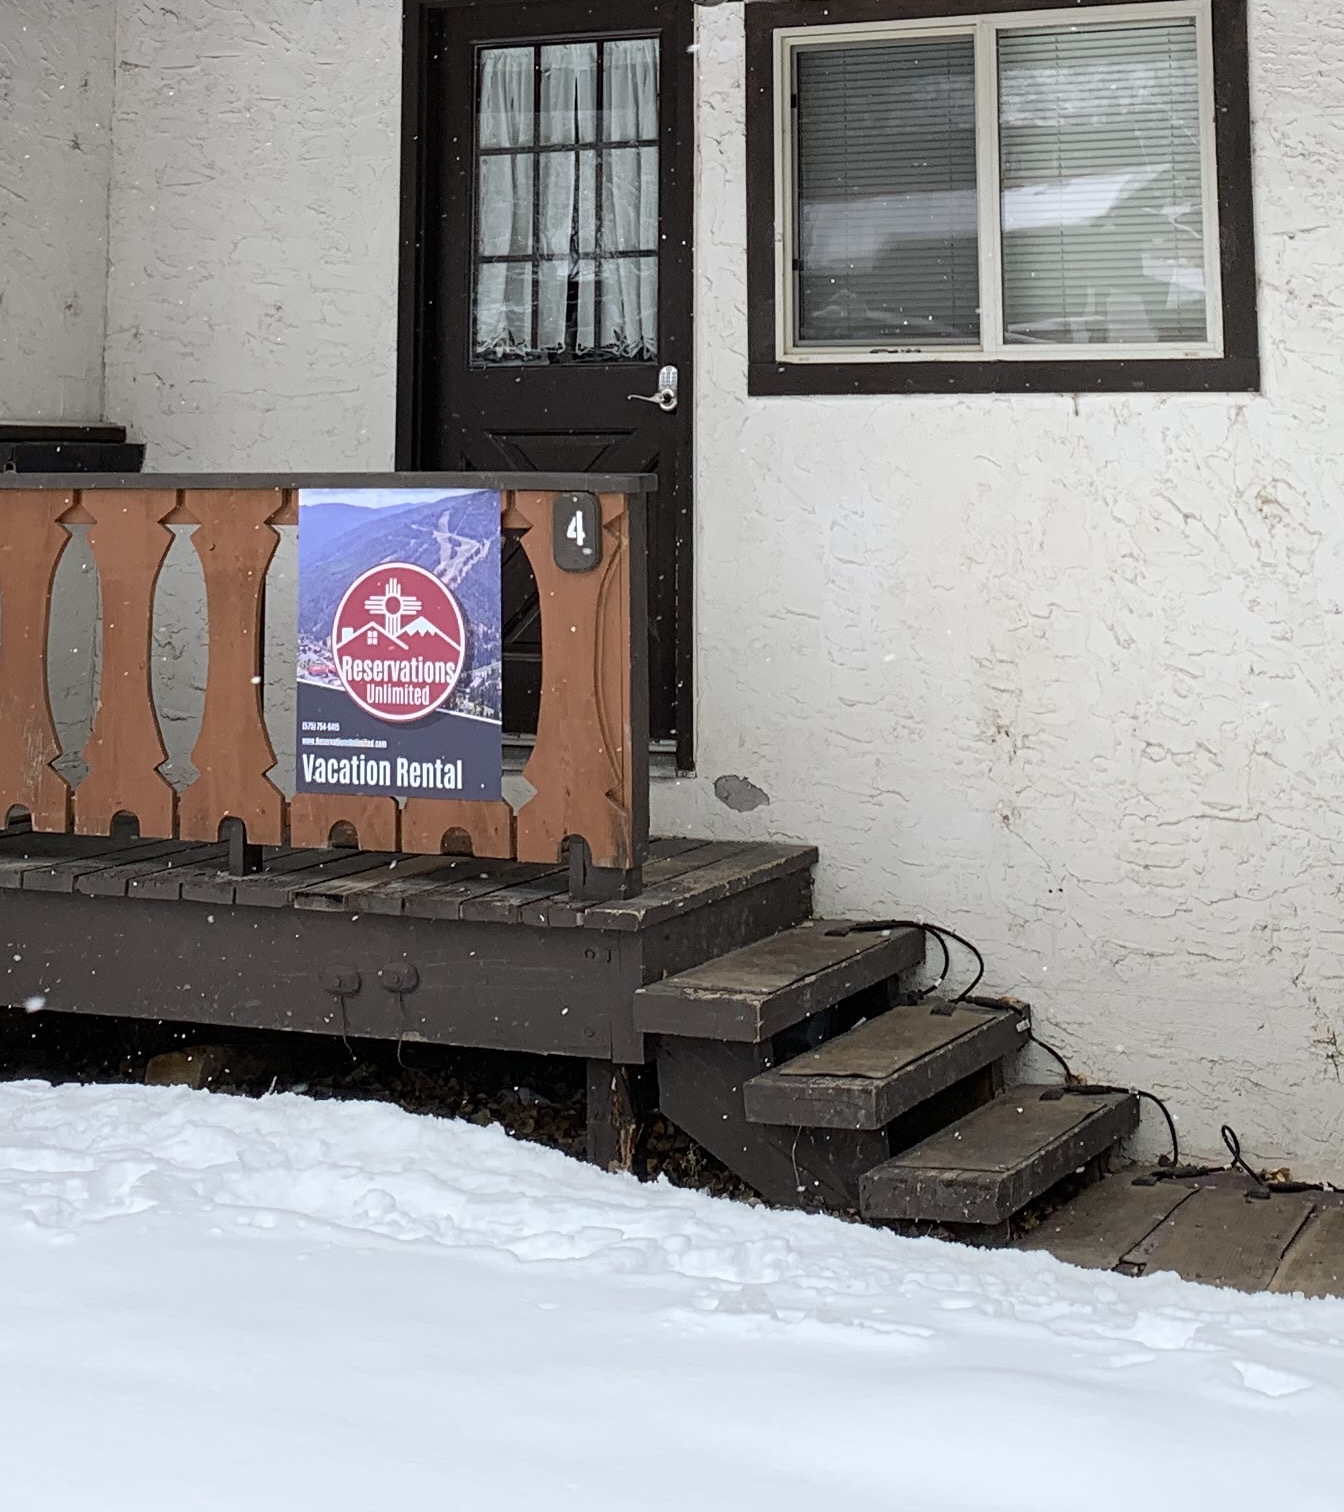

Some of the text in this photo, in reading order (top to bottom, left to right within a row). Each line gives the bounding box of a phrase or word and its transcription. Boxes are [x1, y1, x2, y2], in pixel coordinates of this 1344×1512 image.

[567, 511, 585, 546] 4
[342, 656, 456, 684] Reservations
[366, 684, 430, 705] Unlimited
[302, 754, 463, 789] Vacation Rental
